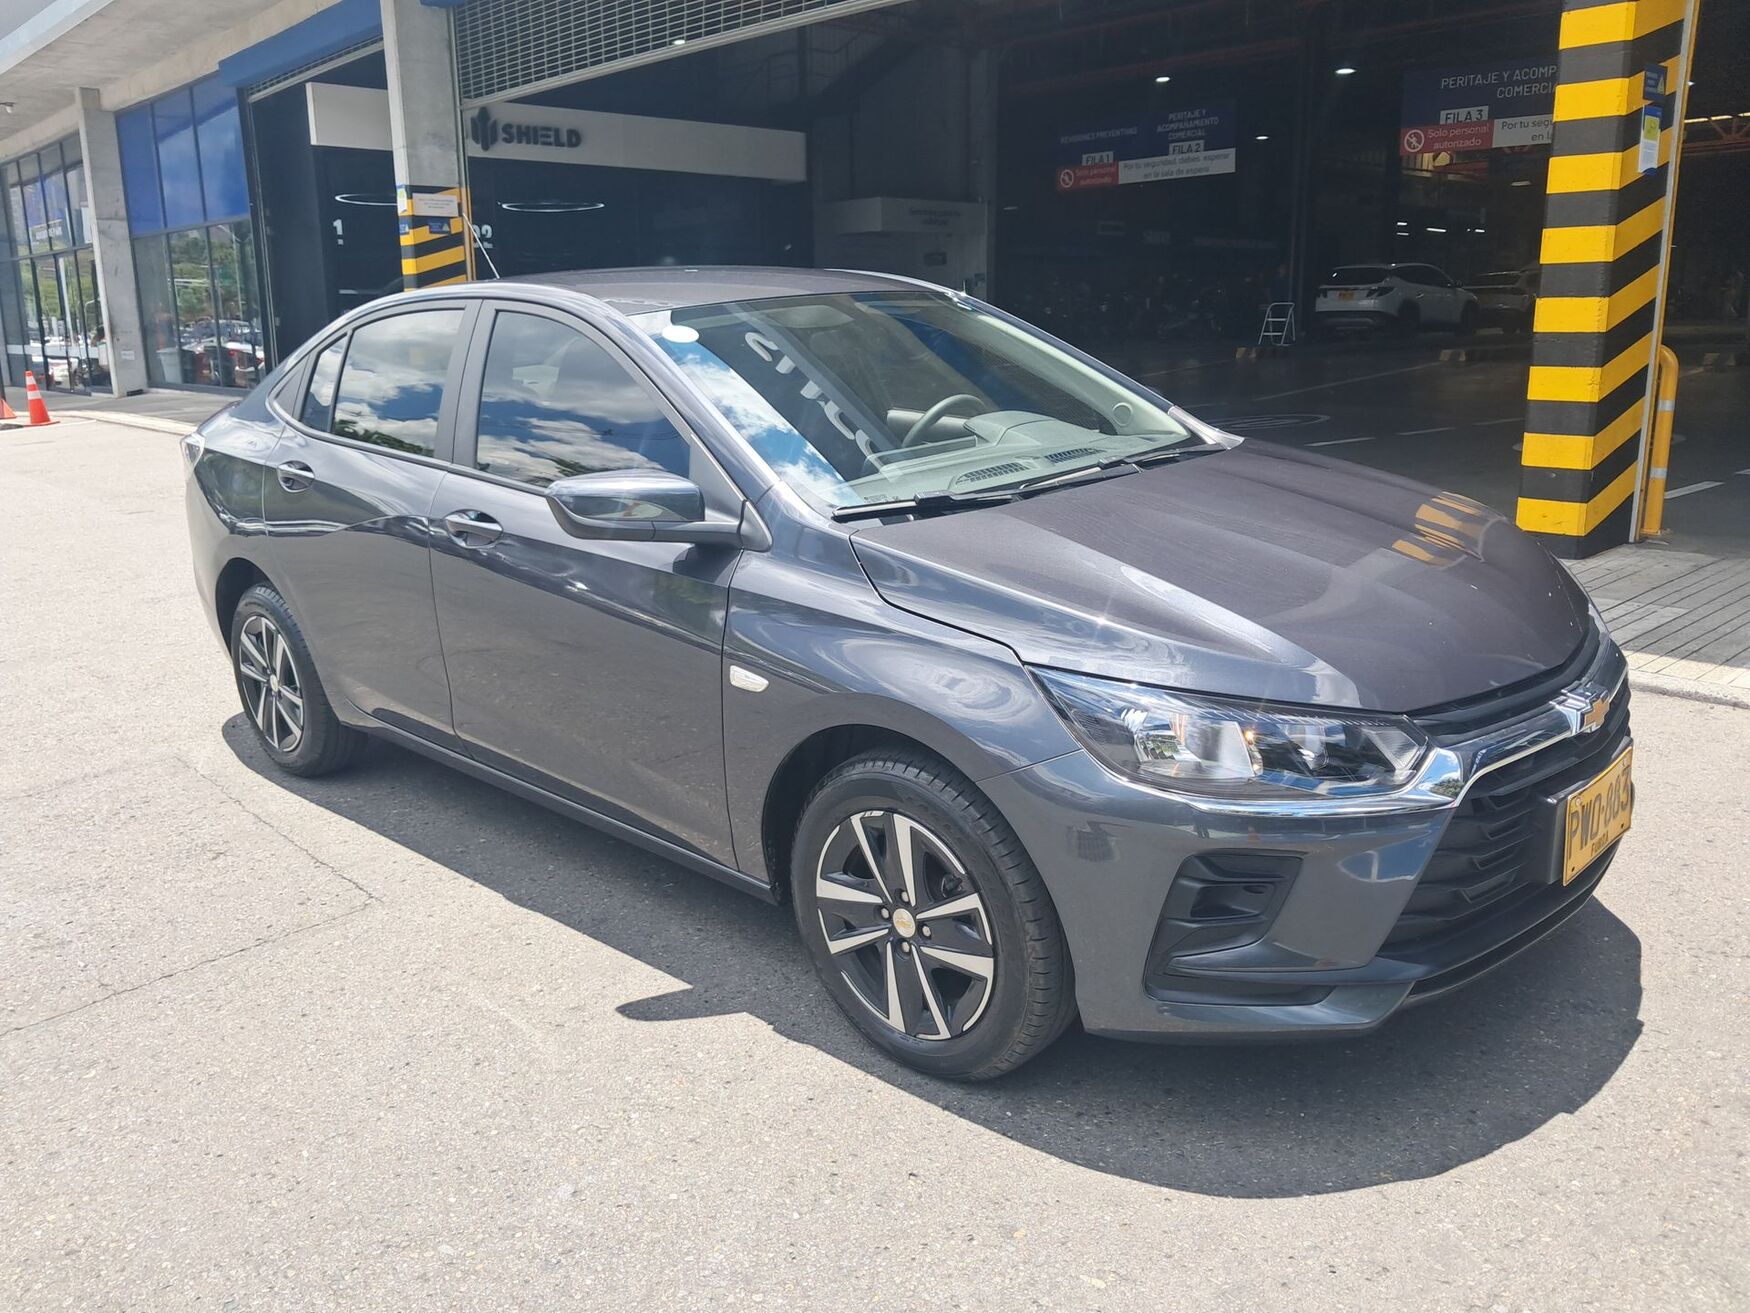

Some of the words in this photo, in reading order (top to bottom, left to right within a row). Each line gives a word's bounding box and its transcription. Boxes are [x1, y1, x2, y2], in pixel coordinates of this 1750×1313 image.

[1441, 72, 1500, 88] PERITAJE
[1503, 71, 1511, 82] Y
[1445, 110, 1473, 125] FILA
[1476, 109, 1484, 121] 3
[1501, 121, 1517, 130] Por
[1520, 120, 1529, 129] tu
[1532, 119, 1553, 130] seg
[502, 123, 582, 149] SHIELD
[1427, 128, 1448, 139] Solo
[1449, 123, 1489, 137] personal
[1532, 133, 1544, 142] en
[1172, 144, 1193, 155] FILA
[1195, 142, 1201, 152] 2
